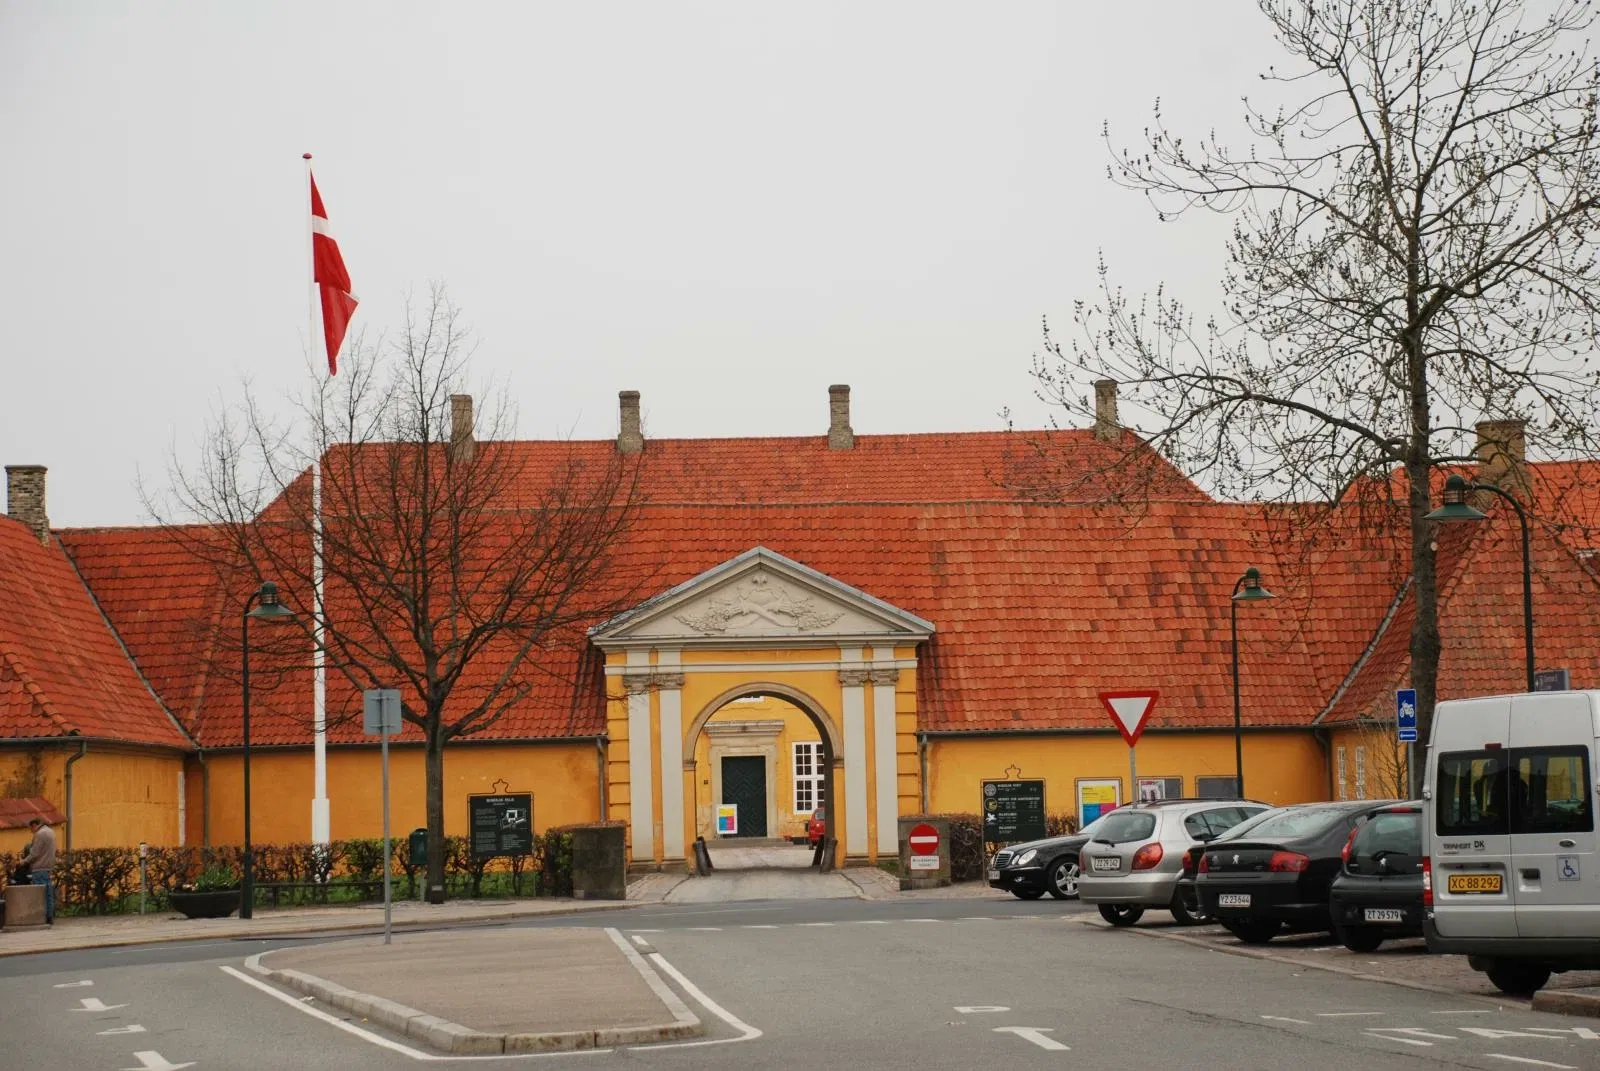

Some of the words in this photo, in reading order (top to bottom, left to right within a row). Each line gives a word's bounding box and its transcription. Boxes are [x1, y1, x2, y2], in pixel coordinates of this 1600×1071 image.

[1474, 840, 1485, 848] DK
[1451, 878, 1465, 888] XC
[1467, 878, 1479, 888] 88
[1481, 877, 1498, 888] 292
[1367, 910, 1376, 919] ZT
[1377, 910, 1385, 919] 29
[1386, 910, 1399, 919] 579
